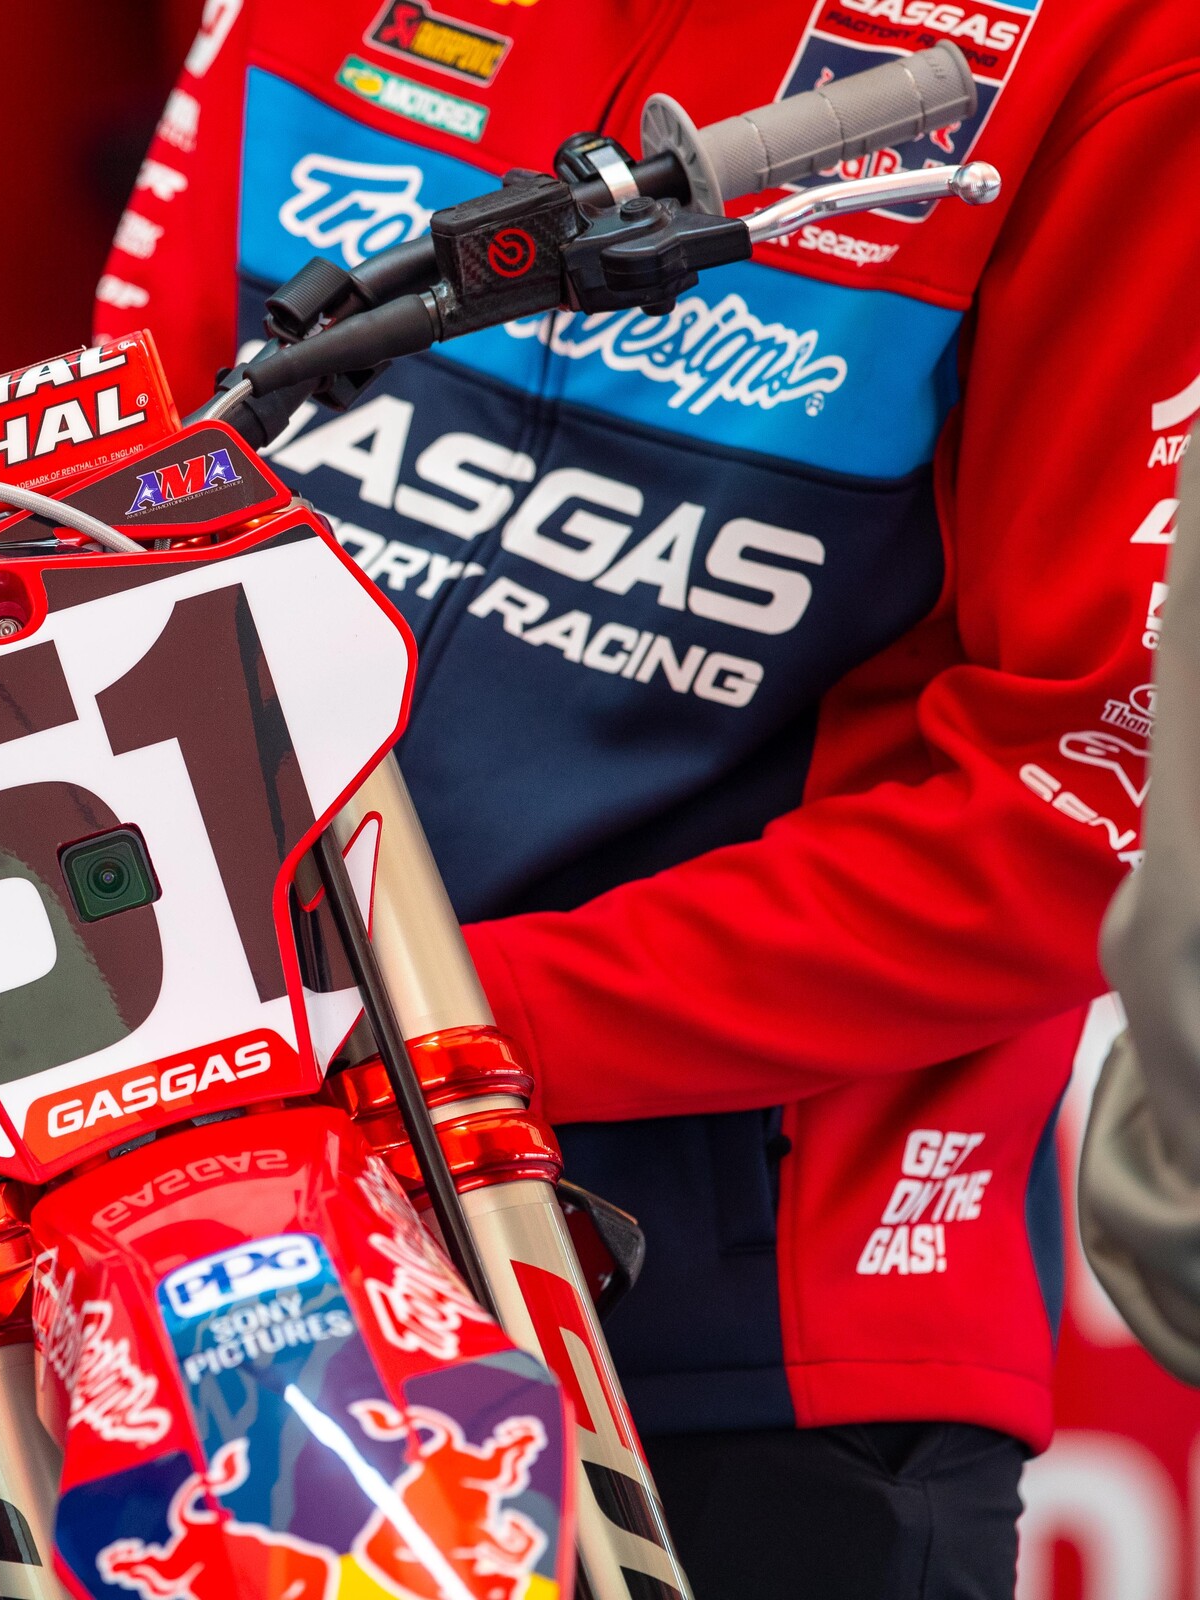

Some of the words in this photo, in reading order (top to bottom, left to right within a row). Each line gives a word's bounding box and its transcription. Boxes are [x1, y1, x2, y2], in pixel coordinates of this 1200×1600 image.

[278, 153, 436, 268] Tro
[14, 475, 49, 490] ADEMARK
[49, 470, 61, 481] OF
[61, 461, 94, 477] RENTHAL
[110, 443, 144, 460] ENGLAND
[125, 448, 242, 515] AMA
[468, 576, 764, 708] RACING
[47, 1041, 273, 1138] GASGAS
[901, 1128, 986, 1179] GET
[880, 1178, 944, 1226] ON
[930, 1169, 993, 1223] THE
[175, 1245, 308, 1304] PPG
[855, 1223, 947, 1275] GAS!
[183, 1308, 353, 1384] PICTURES
[209, 1291, 303, 1343] SONY
